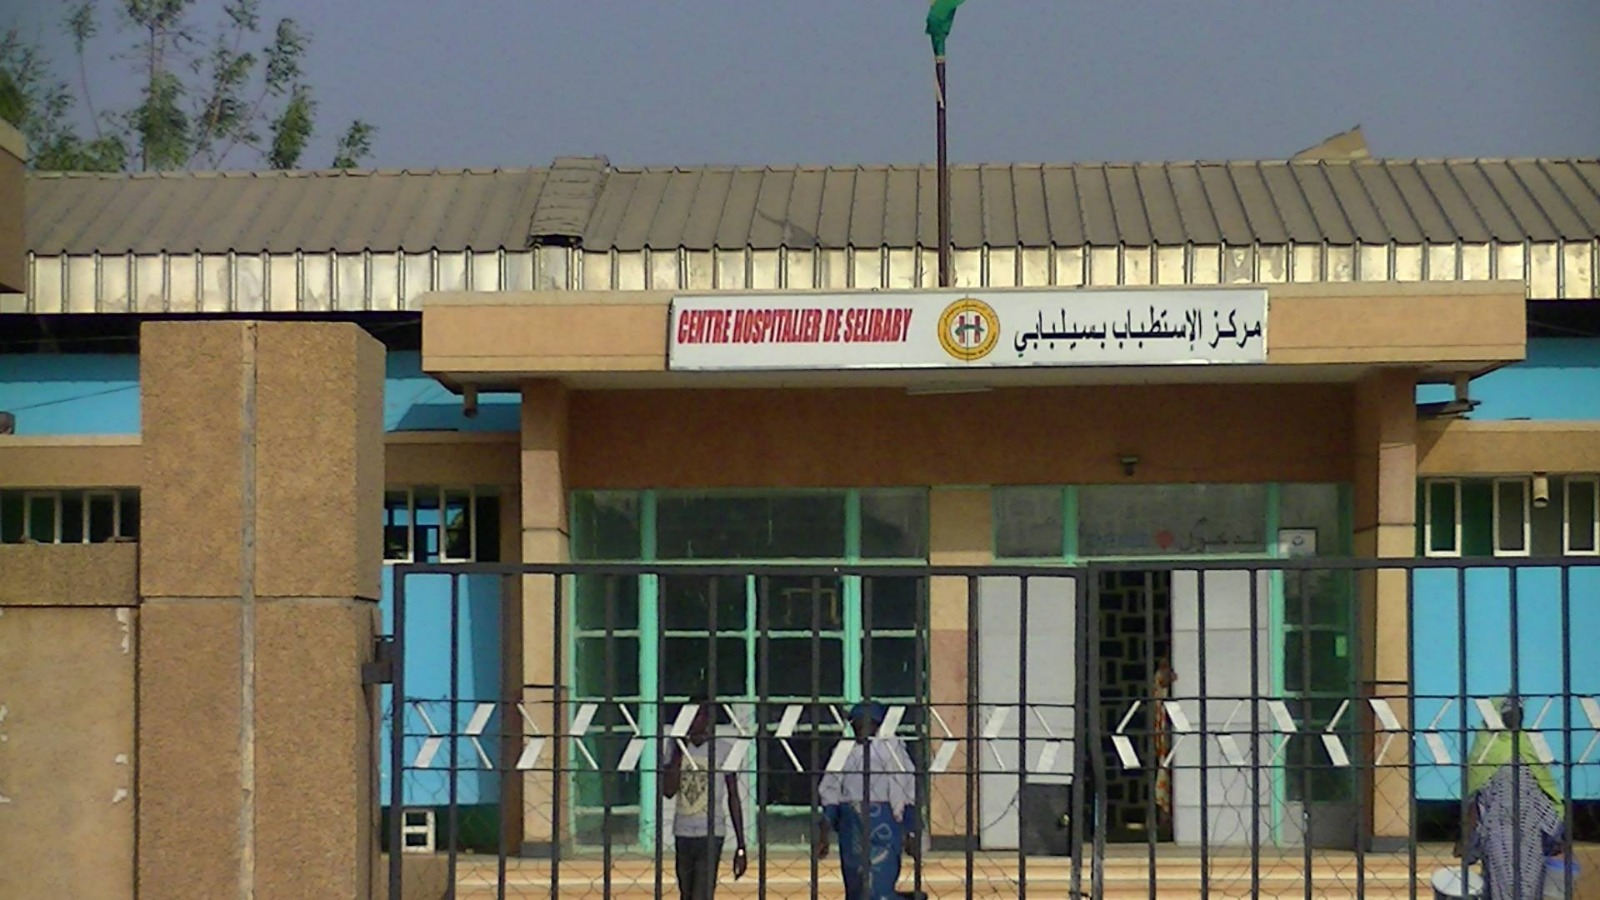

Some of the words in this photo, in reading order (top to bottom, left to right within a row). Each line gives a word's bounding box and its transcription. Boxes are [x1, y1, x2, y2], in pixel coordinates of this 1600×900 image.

[678, 309, 733, 344] CENTRE
[733, 308, 822, 343] HOSPITALIER
[823, 308, 843, 343] DE
[844, 308, 912, 342] SELIBABY
[1014, 308, 1106, 358] بسيلبابي
[1112, 305, 1202, 351] الإستطباب
[1208, 308, 1261, 349] مركز
